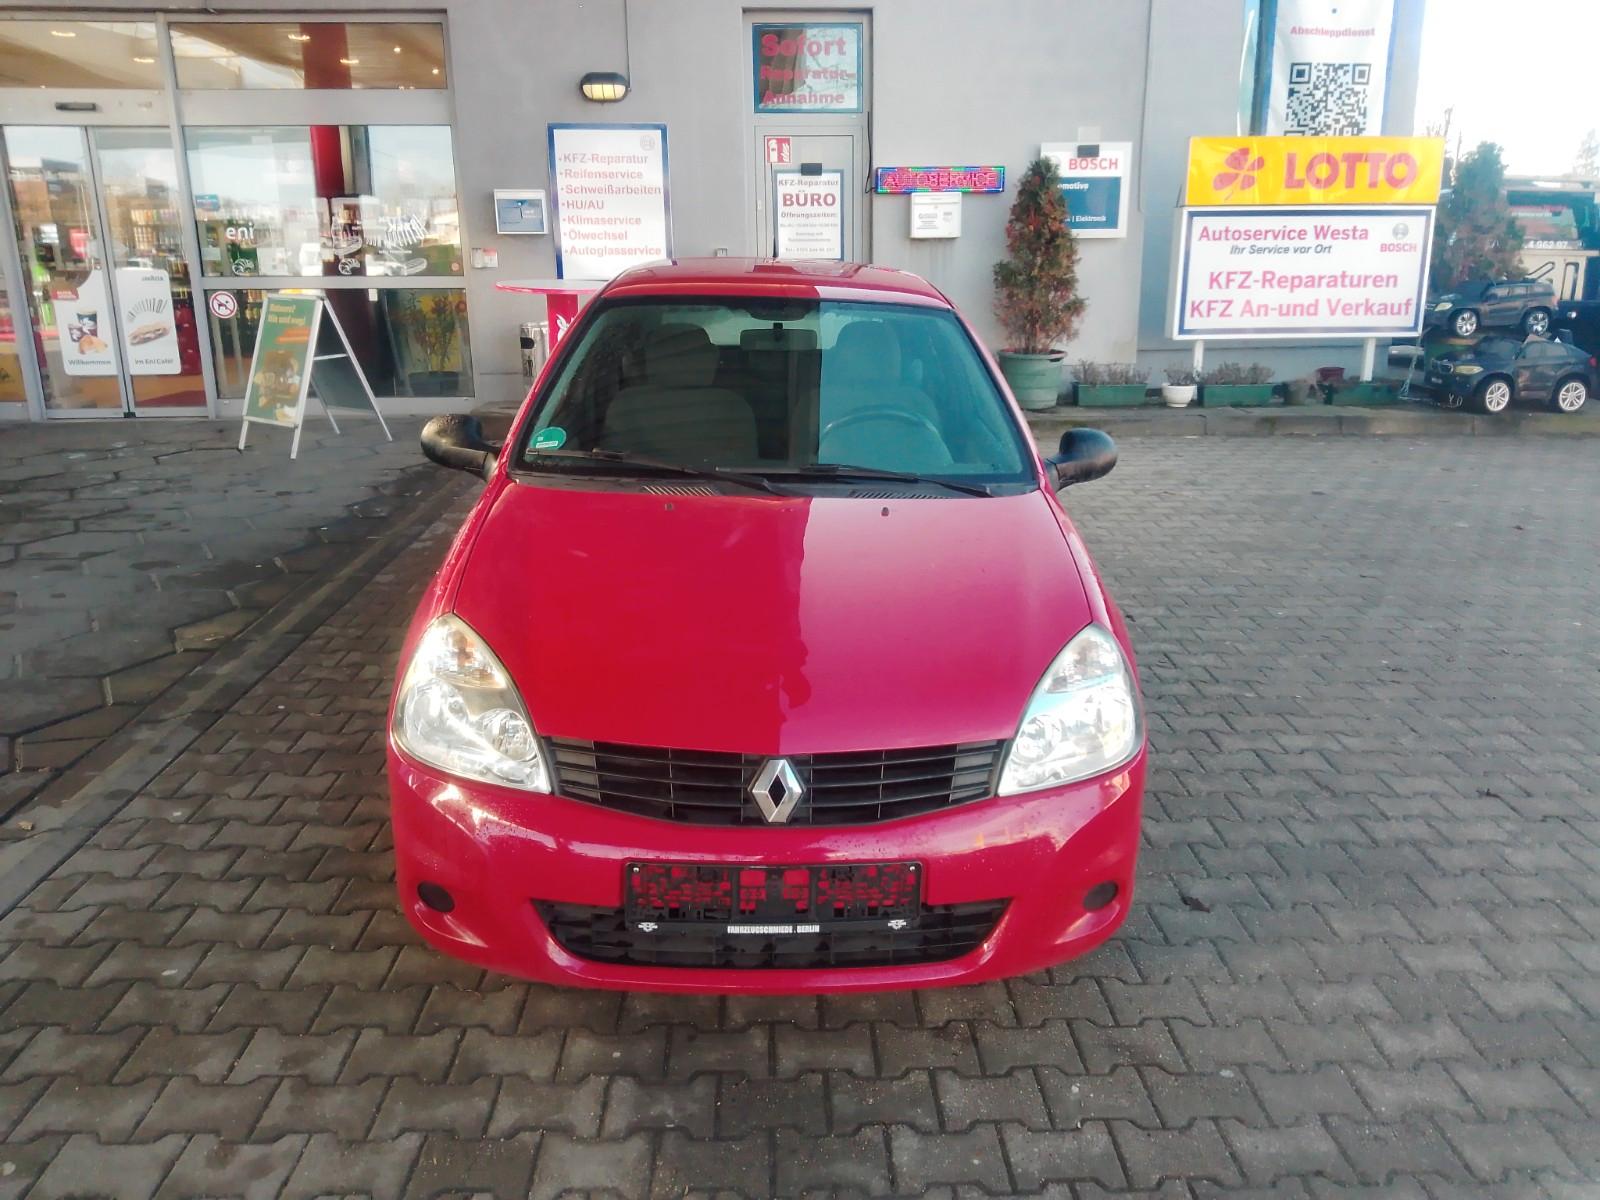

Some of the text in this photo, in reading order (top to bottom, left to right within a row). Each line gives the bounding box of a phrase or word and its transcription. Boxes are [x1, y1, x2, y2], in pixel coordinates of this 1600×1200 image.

[1290, 26, 1375, 38] Abschleppdienst
[762, 34, 846, 56] Sofort
[762, 90, 845, 105] Annahme
[563, 153, 648, 166] KFZ-Reparatur
[1069, 158, 1118, 170] BOSCH
[564, 169, 643, 180] Reifenservice
[1284, 152, 1418, 189] LOTTO
[565, 184, 661, 195] Schweißarbeiten
[782, 190, 836, 207] BÜRO
[566, 200, 604, 210] HU/AU
[567, 215, 642, 226] Klimaservice
[226, 222, 254, 240] eni
[568, 229, 628, 241] Ölwechsel
[1198, 225, 1369, 242] Autoservice Westa
[570, 246, 662, 258] Autoglasservice
[1230, 244, 1332, 255] Ihr Service vor Ort
[1380, 243, 1417, 253] BOSCH
[1208, 270, 1398, 293] KFZ-Reparaturen
[1190, 298, 1413, 318] KFZ An-und Verkauf
